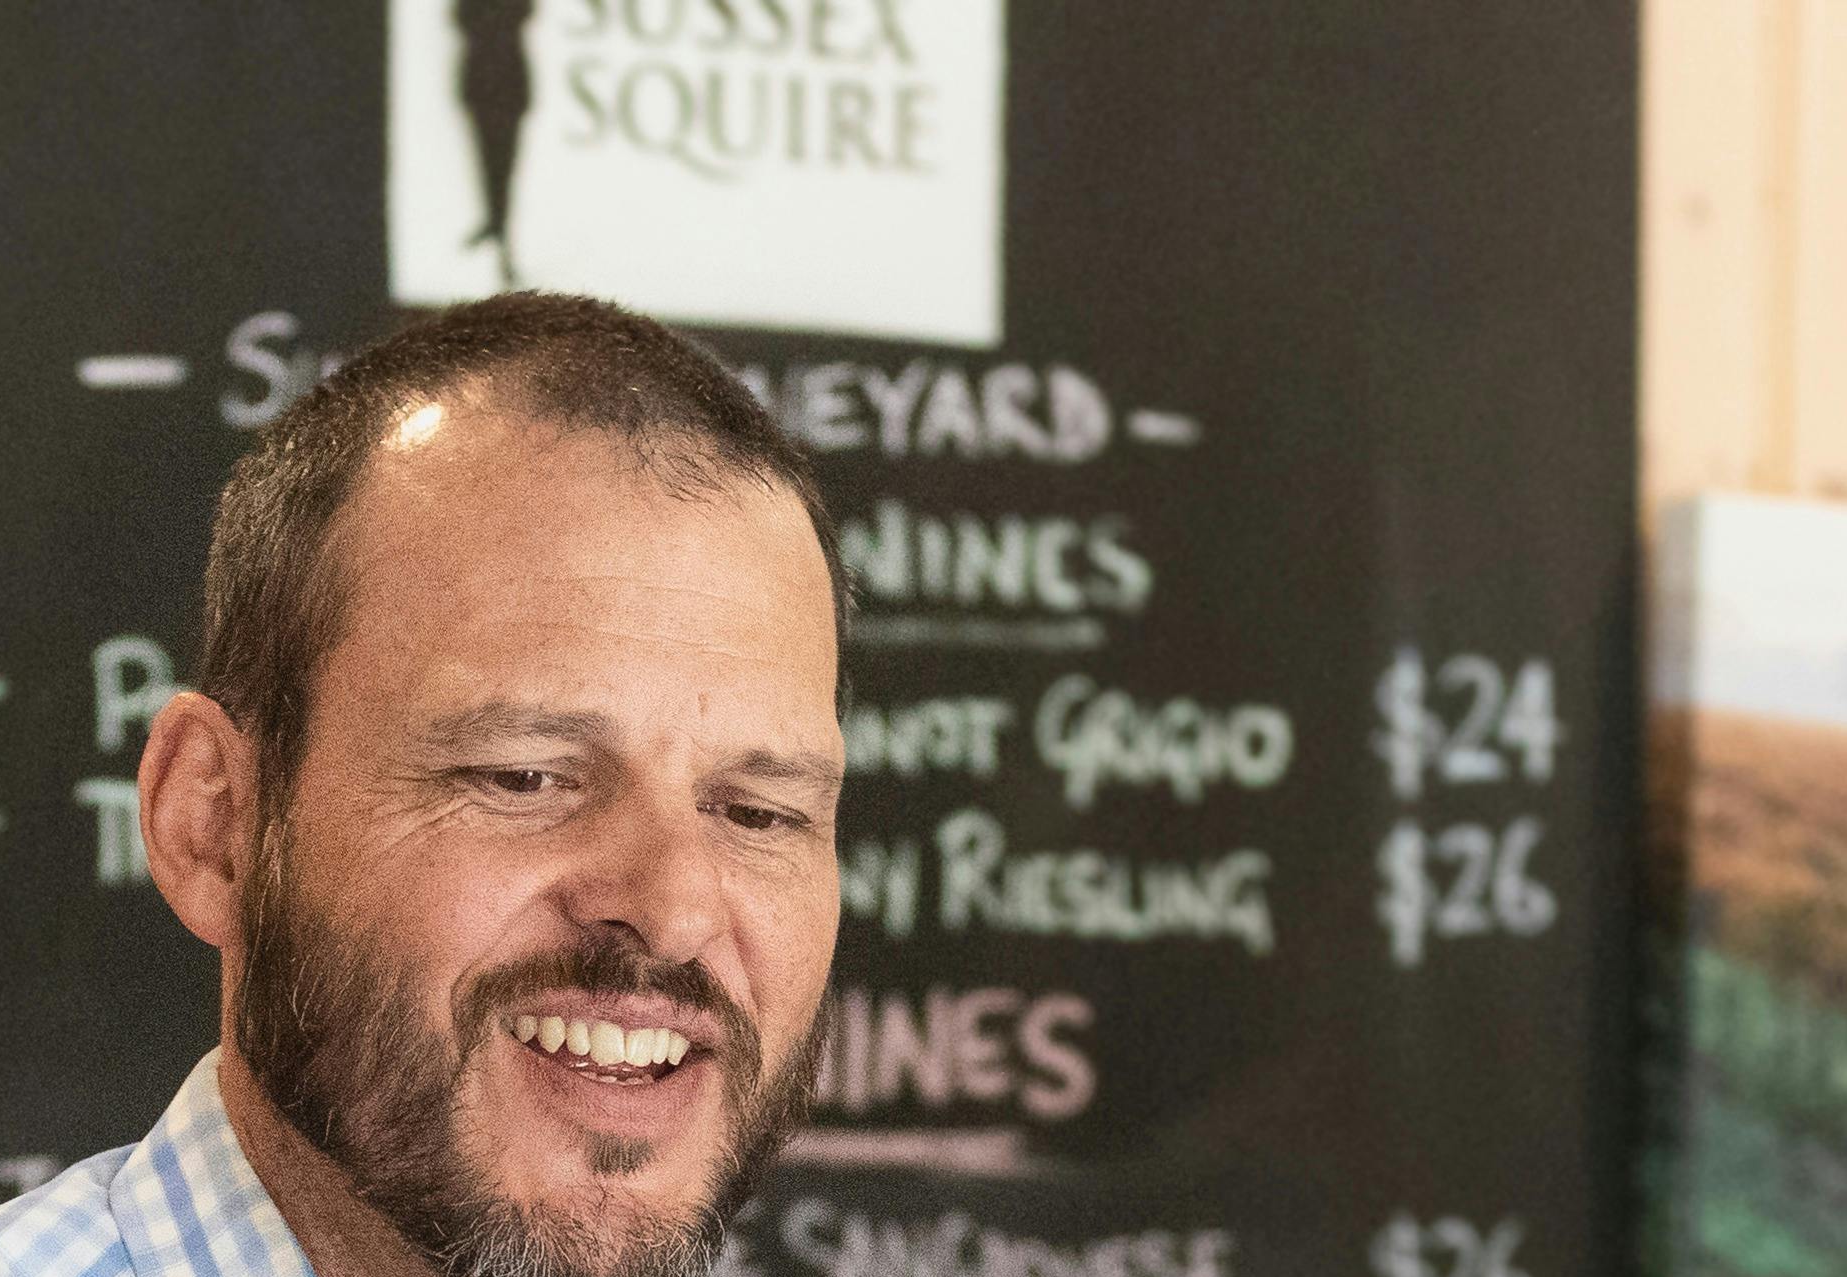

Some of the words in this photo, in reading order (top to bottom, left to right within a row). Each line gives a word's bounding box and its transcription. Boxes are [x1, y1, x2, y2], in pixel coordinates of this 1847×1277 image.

[561, 55, 943, 184] SQUIRE
[1373, 645, 1563, 796] $24
[1375, 816, 1558, 966] $26
